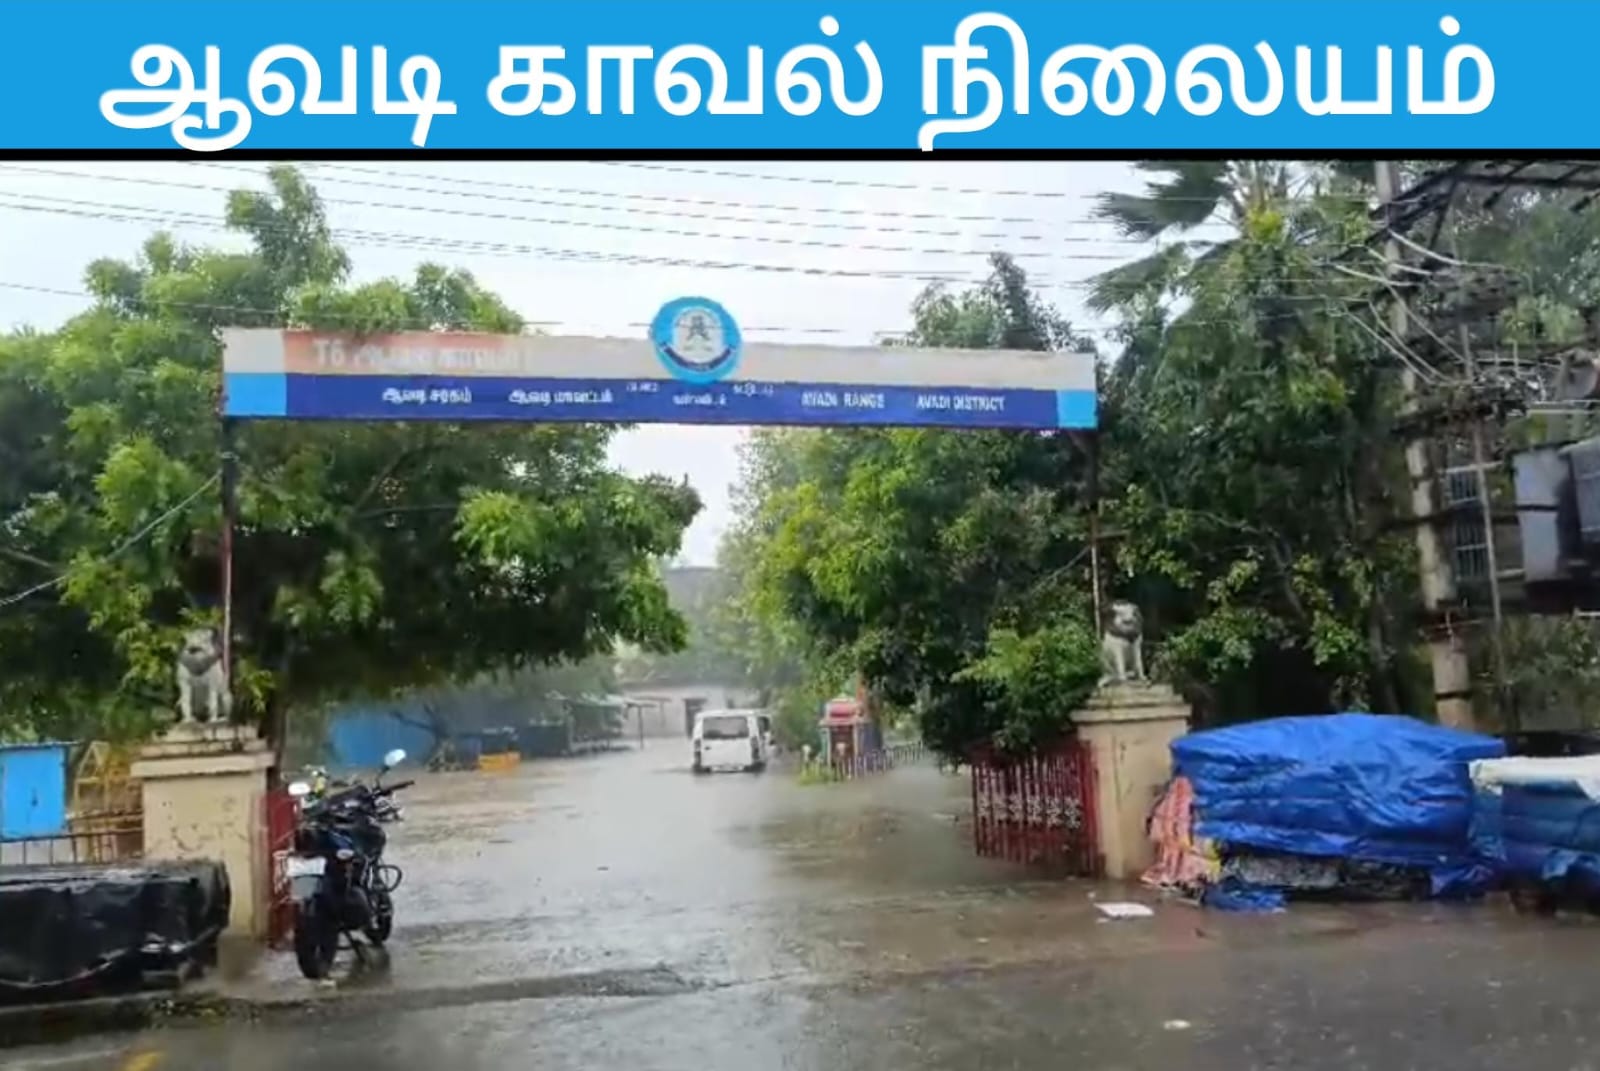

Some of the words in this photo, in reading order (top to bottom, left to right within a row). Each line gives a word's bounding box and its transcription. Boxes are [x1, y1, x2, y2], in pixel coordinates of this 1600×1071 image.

[844, 392, 885, 409] RANGE
[916, 394, 951, 410] AVADI
[954, 394, 1006, 411] DISTRICT
